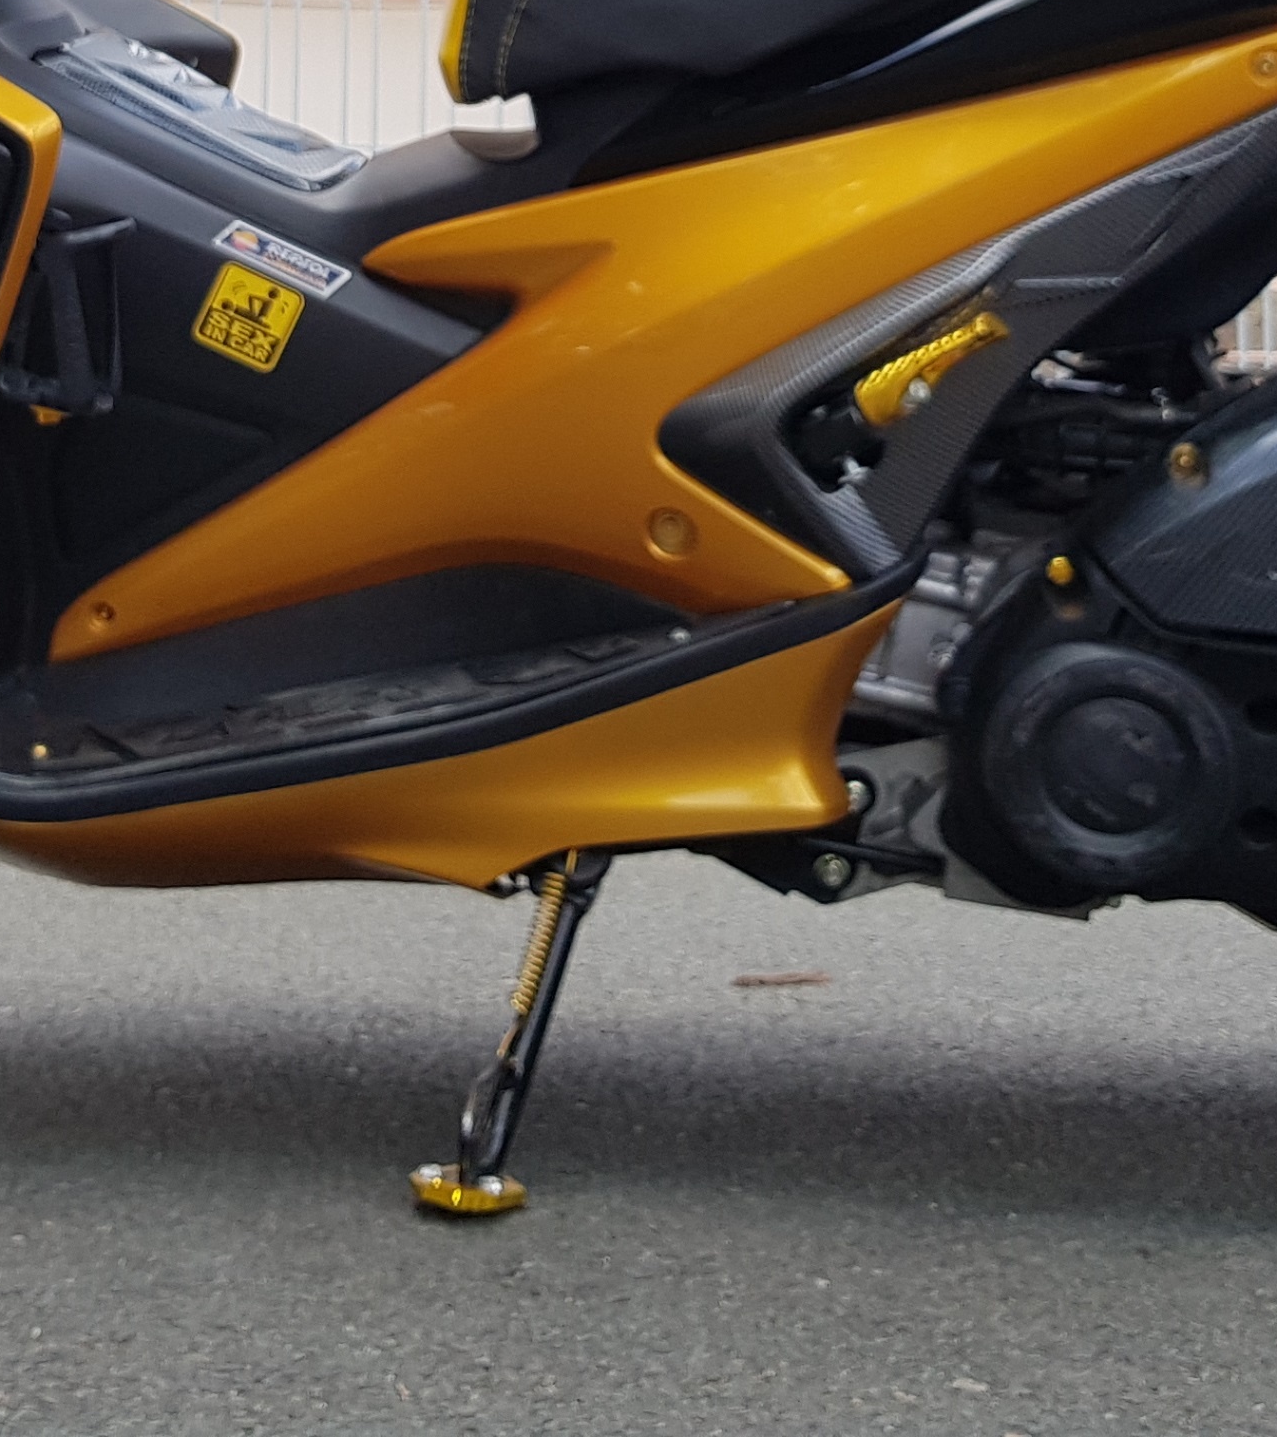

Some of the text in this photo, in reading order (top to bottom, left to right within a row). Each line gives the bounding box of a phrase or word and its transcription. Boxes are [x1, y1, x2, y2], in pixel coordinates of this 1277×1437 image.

[204, 325, 271, 363] IN CAR
[208, 310, 277, 354] SEX
